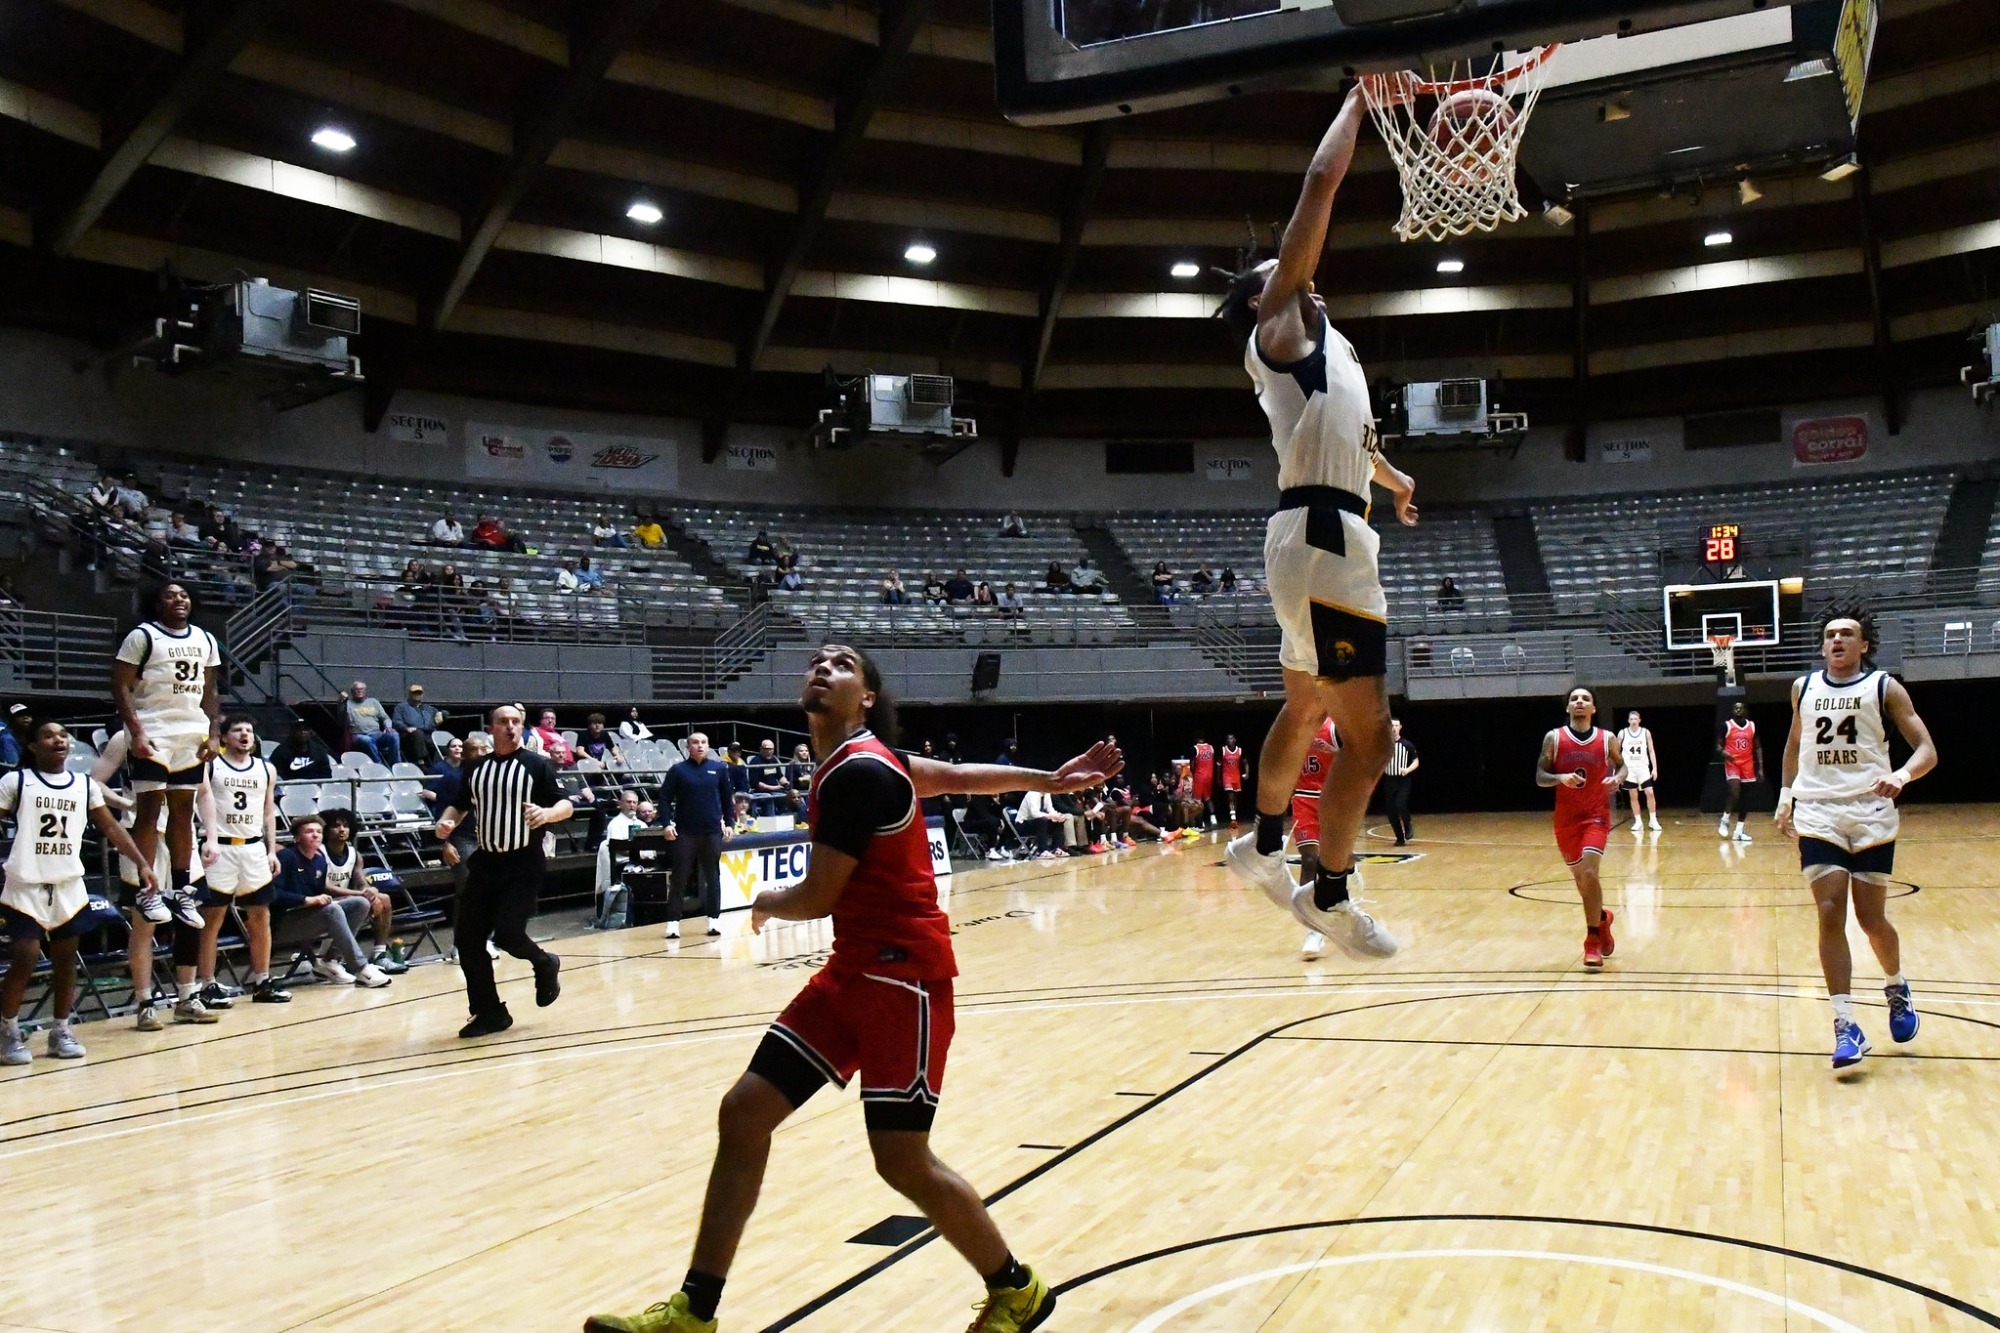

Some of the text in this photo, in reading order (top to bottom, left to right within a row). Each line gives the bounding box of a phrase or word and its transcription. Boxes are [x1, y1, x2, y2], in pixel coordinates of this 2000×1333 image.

[391, 415, 446, 431] SECTION
[414, 428, 423, 439] 5
[1603, 440, 1650, 451] SECTION
[728, 446, 775, 459] SECTION
[747, 458, 755, 467] 6
[1207, 459, 1251, 470] SECTION
[1711, 525, 1739, 538] 1:34
[1706, 539, 1735, 561] 28
[168, 647, 203, 658] GOLDEN
[175, 660, 199, 681] 31
[1814, 696, 1861, 711] GOLDEN
[1815, 715, 1858, 745] 24
[1629, 746, 1642, 755] 44
[1817, 749, 1858, 765] BEARS
[223, 777, 258, 789] GOLDEN
[35, 796, 77, 812] GOLDEN
[233, 791, 247, 811] 3
[226, 814, 254, 824] BEARS
[39, 813, 69, 839] 21
[35, 842, 73, 856] BEARS
[372, 872, 394, 882] TECH
